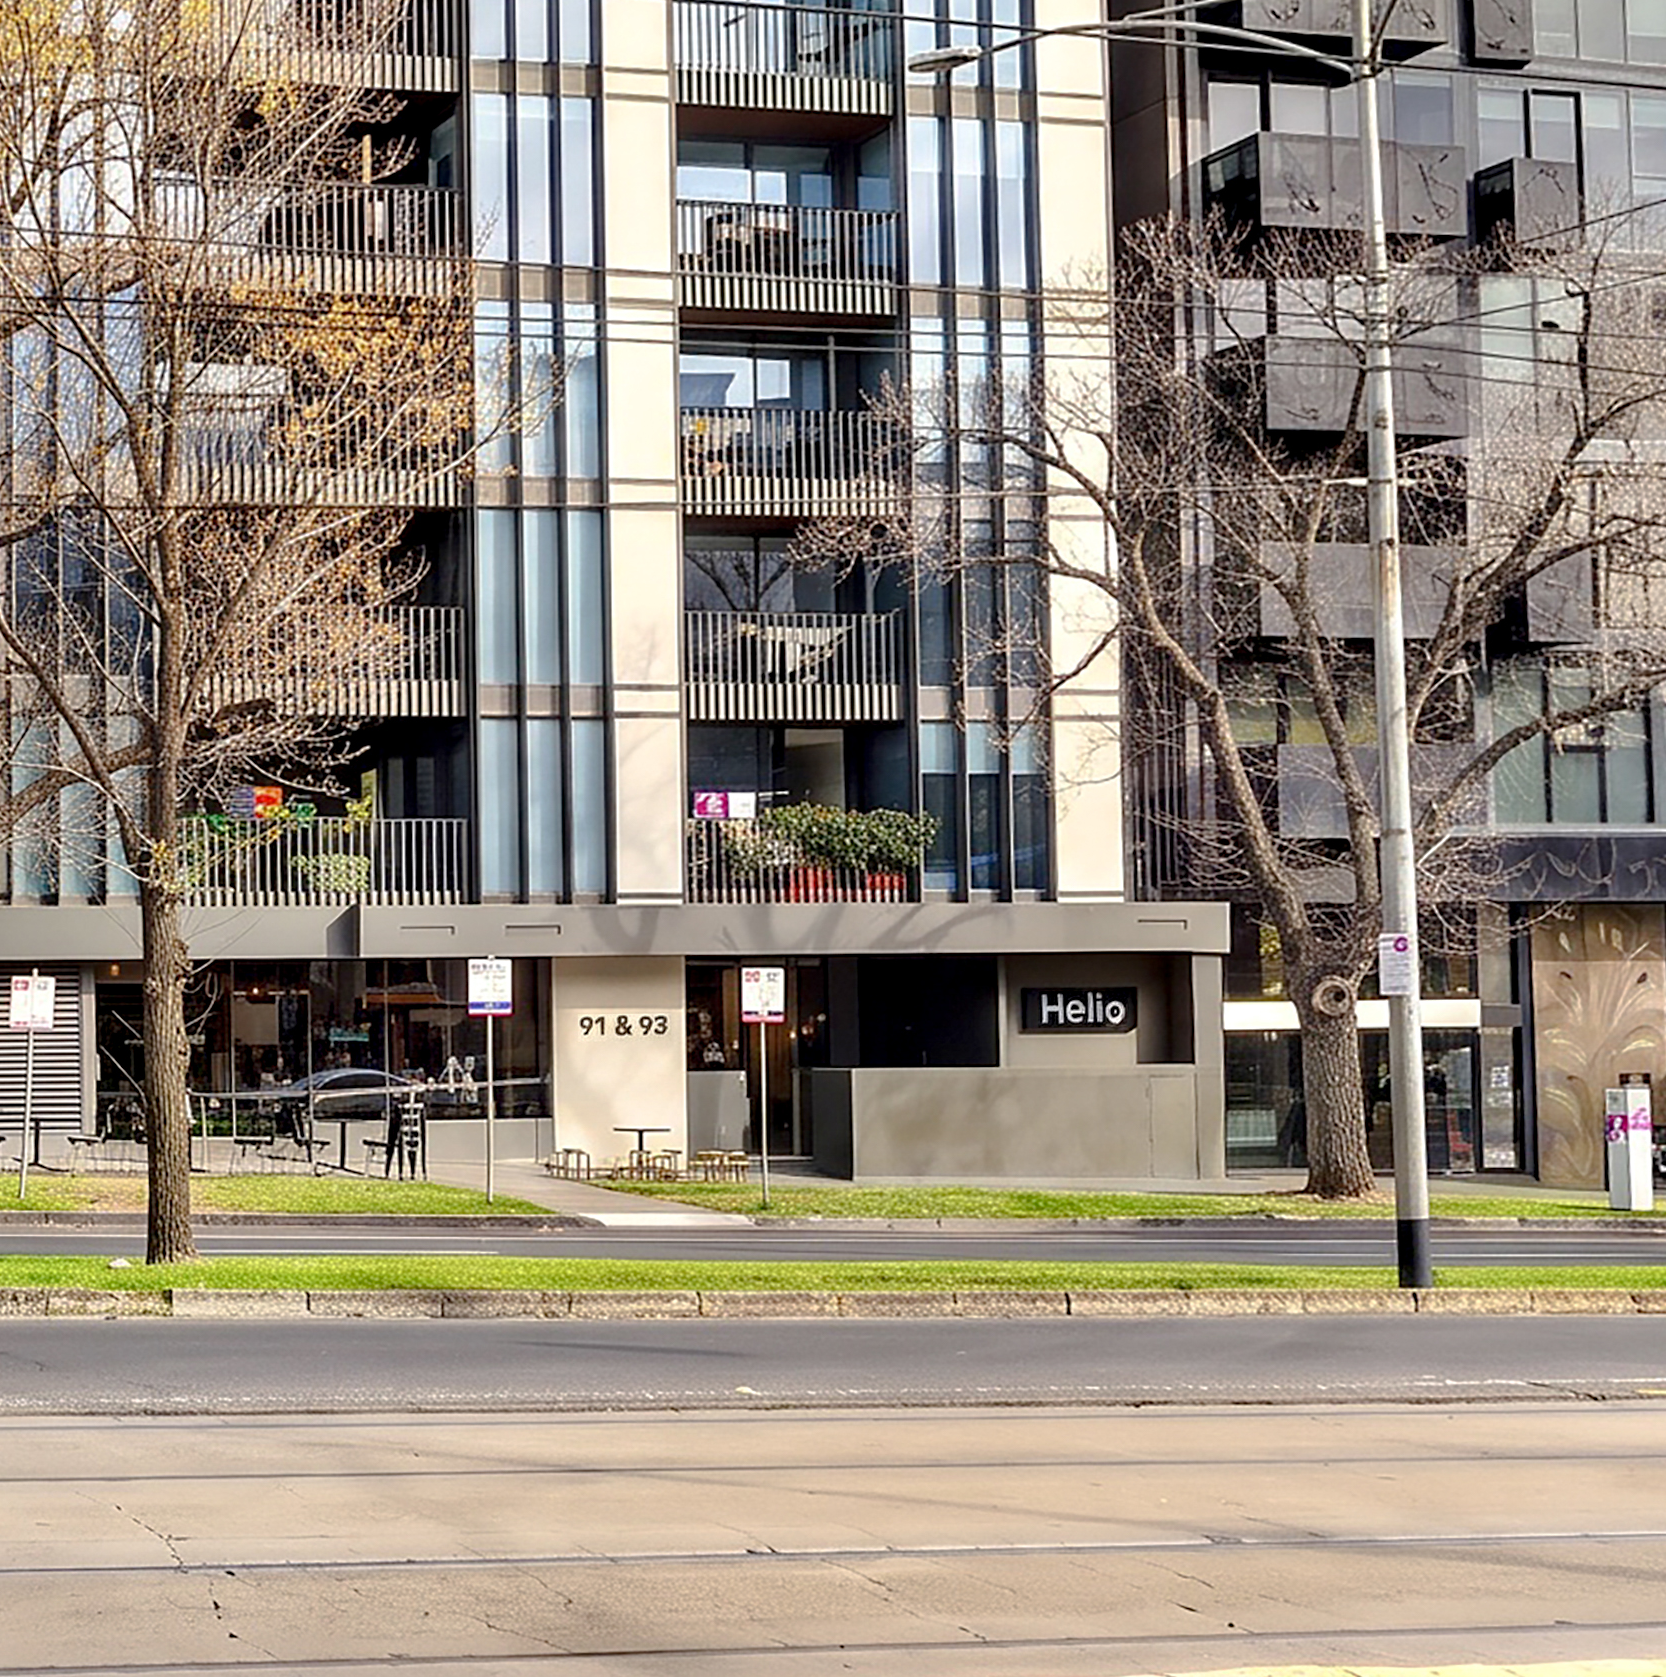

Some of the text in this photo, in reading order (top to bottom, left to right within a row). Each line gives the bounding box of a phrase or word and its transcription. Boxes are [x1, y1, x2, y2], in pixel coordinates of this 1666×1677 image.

[1041, 991, 1126, 1024] Helio
[579, 1015, 668, 1036] 91 & 93
